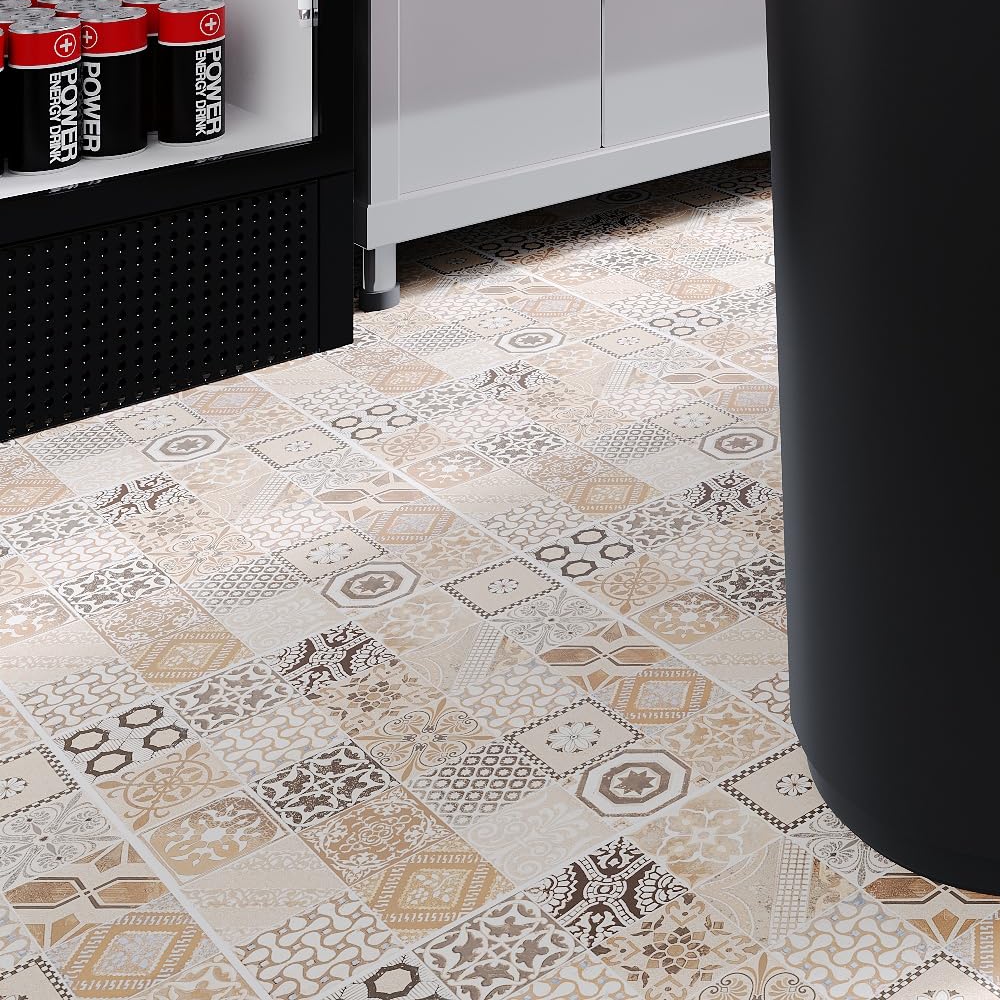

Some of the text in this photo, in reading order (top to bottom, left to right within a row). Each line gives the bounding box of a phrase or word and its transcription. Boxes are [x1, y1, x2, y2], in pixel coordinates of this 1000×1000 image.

[49, 72, 61, 164] ENERGY DRINK
[61, 67, 78, 163] POWER
[83, 62, 101, 152] POWER
[195, 50, 206, 137] ENERGY DRINK
[206, 46, 222, 135] POWER
